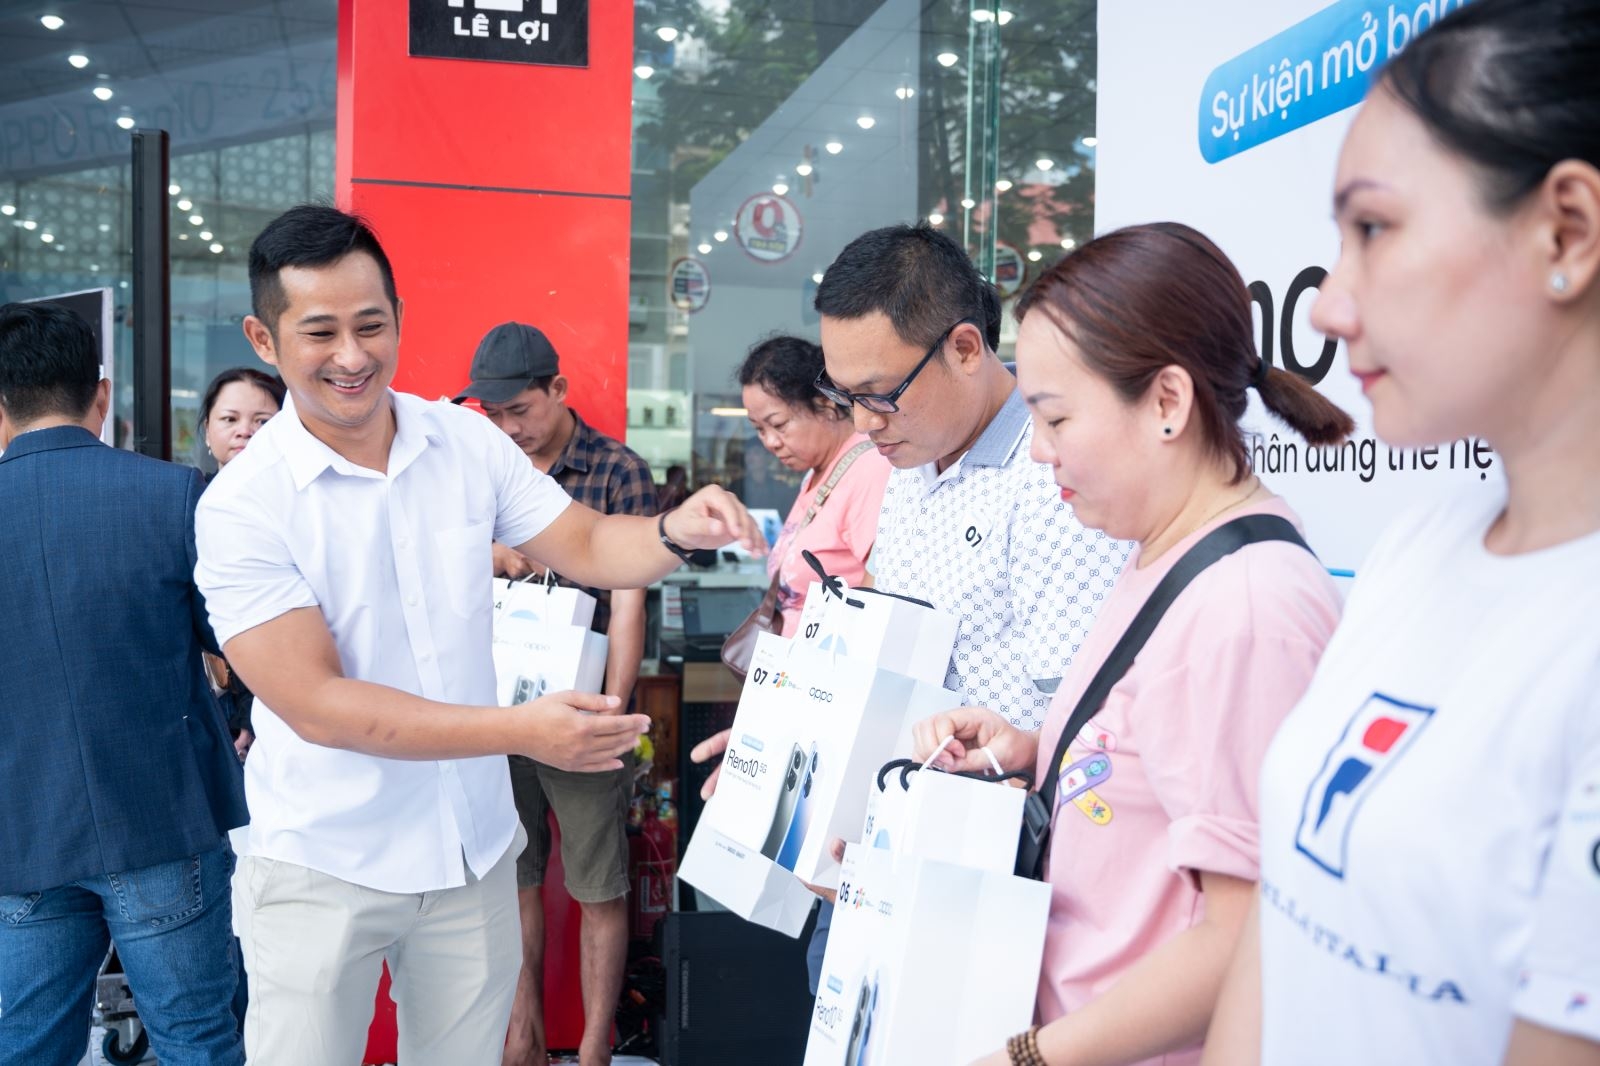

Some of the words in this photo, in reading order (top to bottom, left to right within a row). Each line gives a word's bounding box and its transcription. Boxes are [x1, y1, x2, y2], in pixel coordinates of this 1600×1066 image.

[453, 13, 490, 38] LÊ
[500, 19, 550, 45] LỢI
[1211, 83, 1249, 141] Sự
[1252, 57, 1313, 120] kiện
[1321, 11, 1379, 90] mở
[1251, 433, 1298, 474] hân
[965, 525, 983, 548] 07
[804, 622, 820, 639] 07
[753, 667, 769, 686] 07
[726, 748, 760, 778] Reno10
[839, 880, 851, 903] 06
